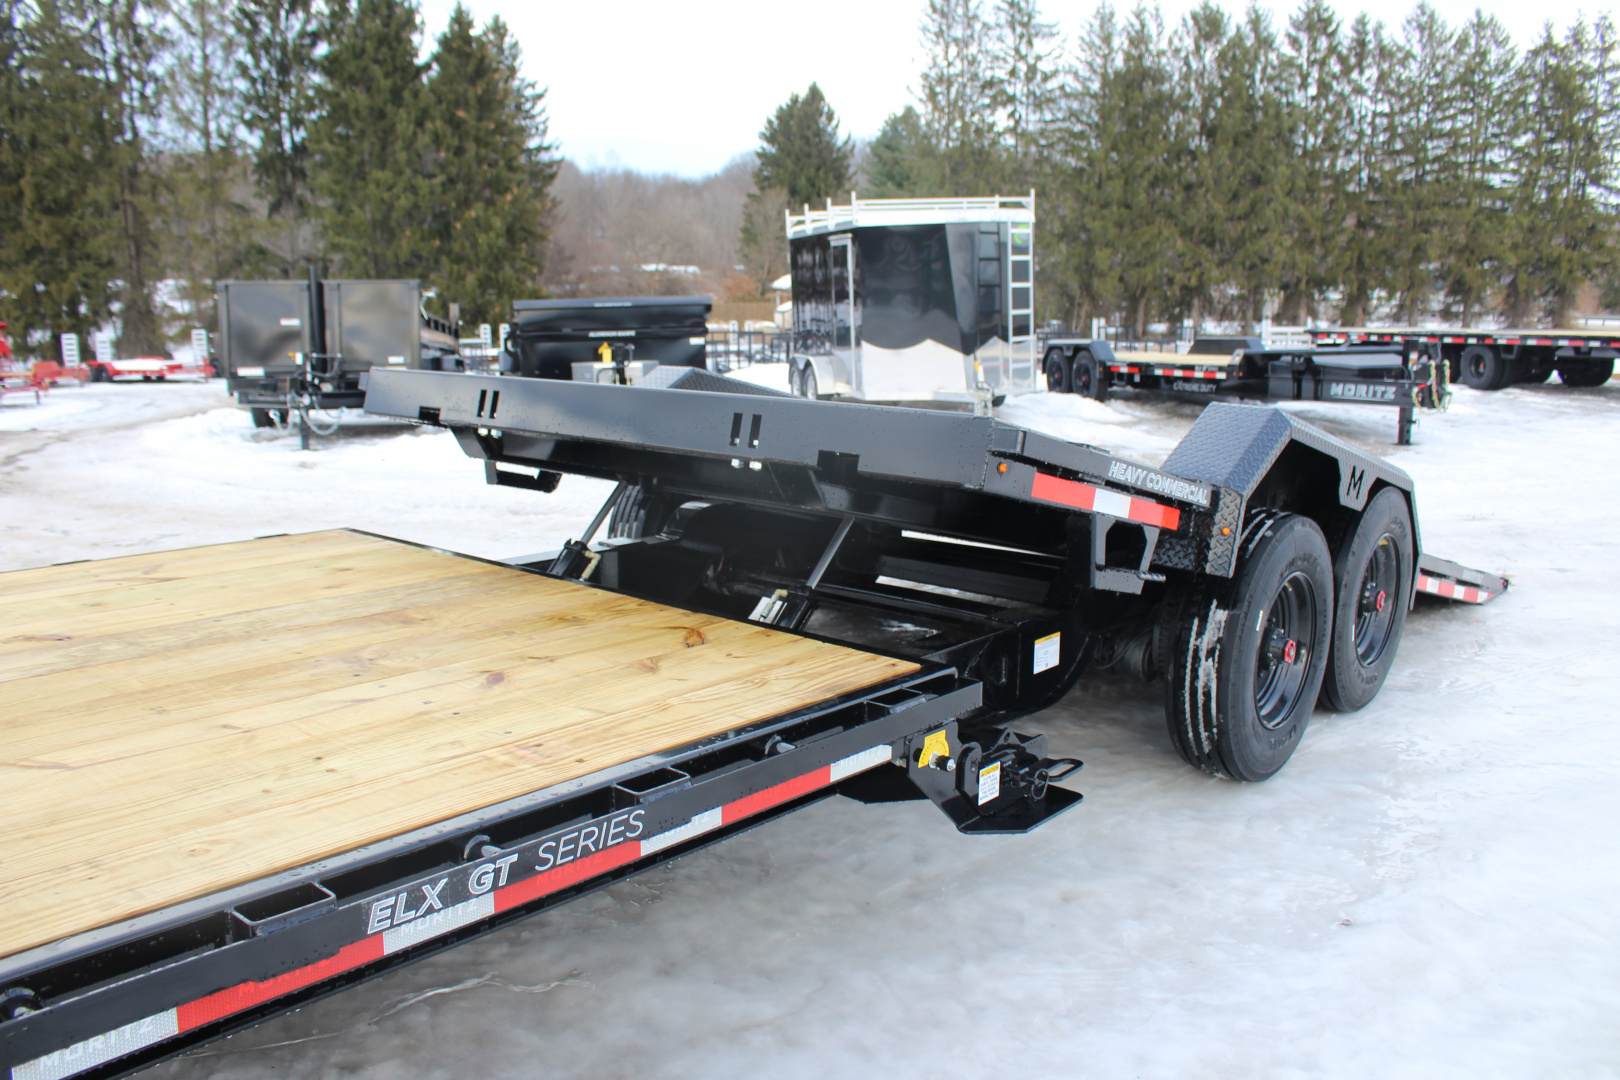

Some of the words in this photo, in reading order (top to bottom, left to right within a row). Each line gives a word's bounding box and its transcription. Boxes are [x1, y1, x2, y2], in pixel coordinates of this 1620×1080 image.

[1200, 383, 1217, 394] DUTY
[1330, 382, 1397, 400] MORITZ
[1108, 460, 1147, 486] HEAVY
[1146, 472, 1208, 505] COMMERCIAL
[1346, 465, 1365, 500] M
[367, 878, 449, 935] ELX
[468, 852, 519, 896] GT
[534, 808, 646, 873] SERIES
